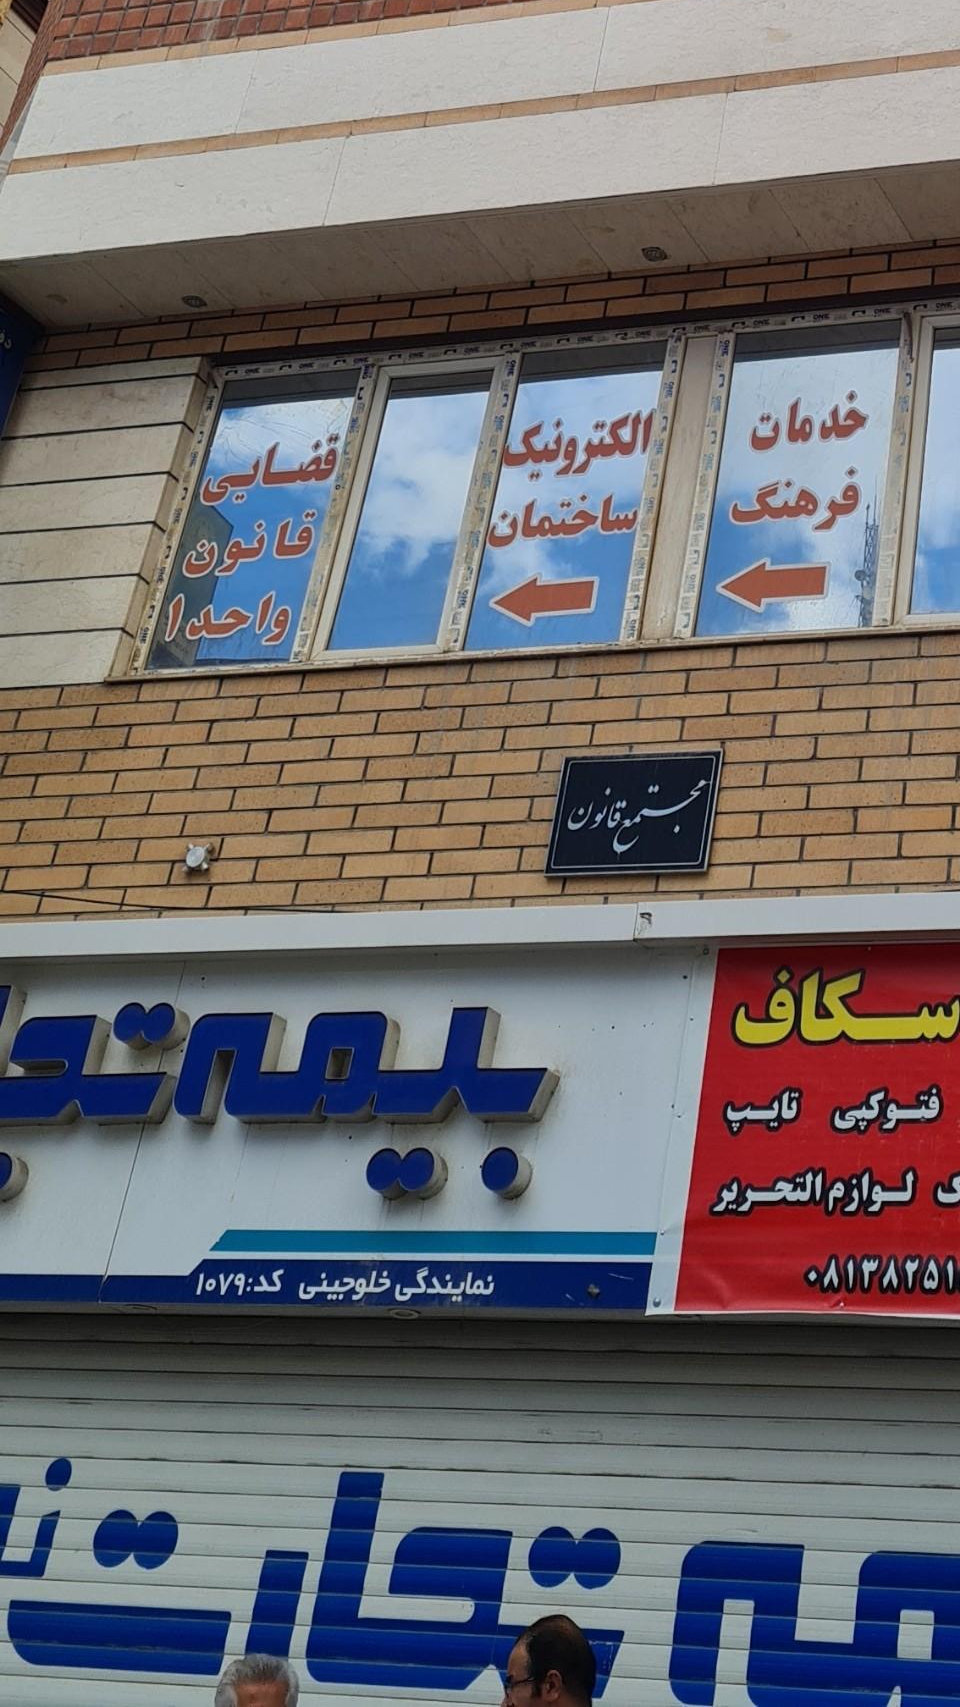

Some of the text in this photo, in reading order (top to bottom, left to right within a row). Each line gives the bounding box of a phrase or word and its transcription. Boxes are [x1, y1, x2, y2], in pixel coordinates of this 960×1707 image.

[500, 409, 656, 482] الکترونیک
[749, 390, 870, 454] خدمات
[201, 433, 340, 505] قضایی
[487, 494, 638, 549] ساختمان
[729, 466, 861, 532] فرهنگ
[183, 510, 318, 578] قانون
[567, 780, 712, 854] مجتمع قانون
[174, 1006, 552, 1196] بیمه
[724, 1088, 799, 1136] تایپ
[832, 1085, 941, 1134] فتوکپی
[711, 1170, 823, 1216] التحریر
[827, 1172, 914, 1213] لوازم
[298, 1270, 392, 1300] خلوجینی
[395, 1267, 495, 1302] نمایندگی
